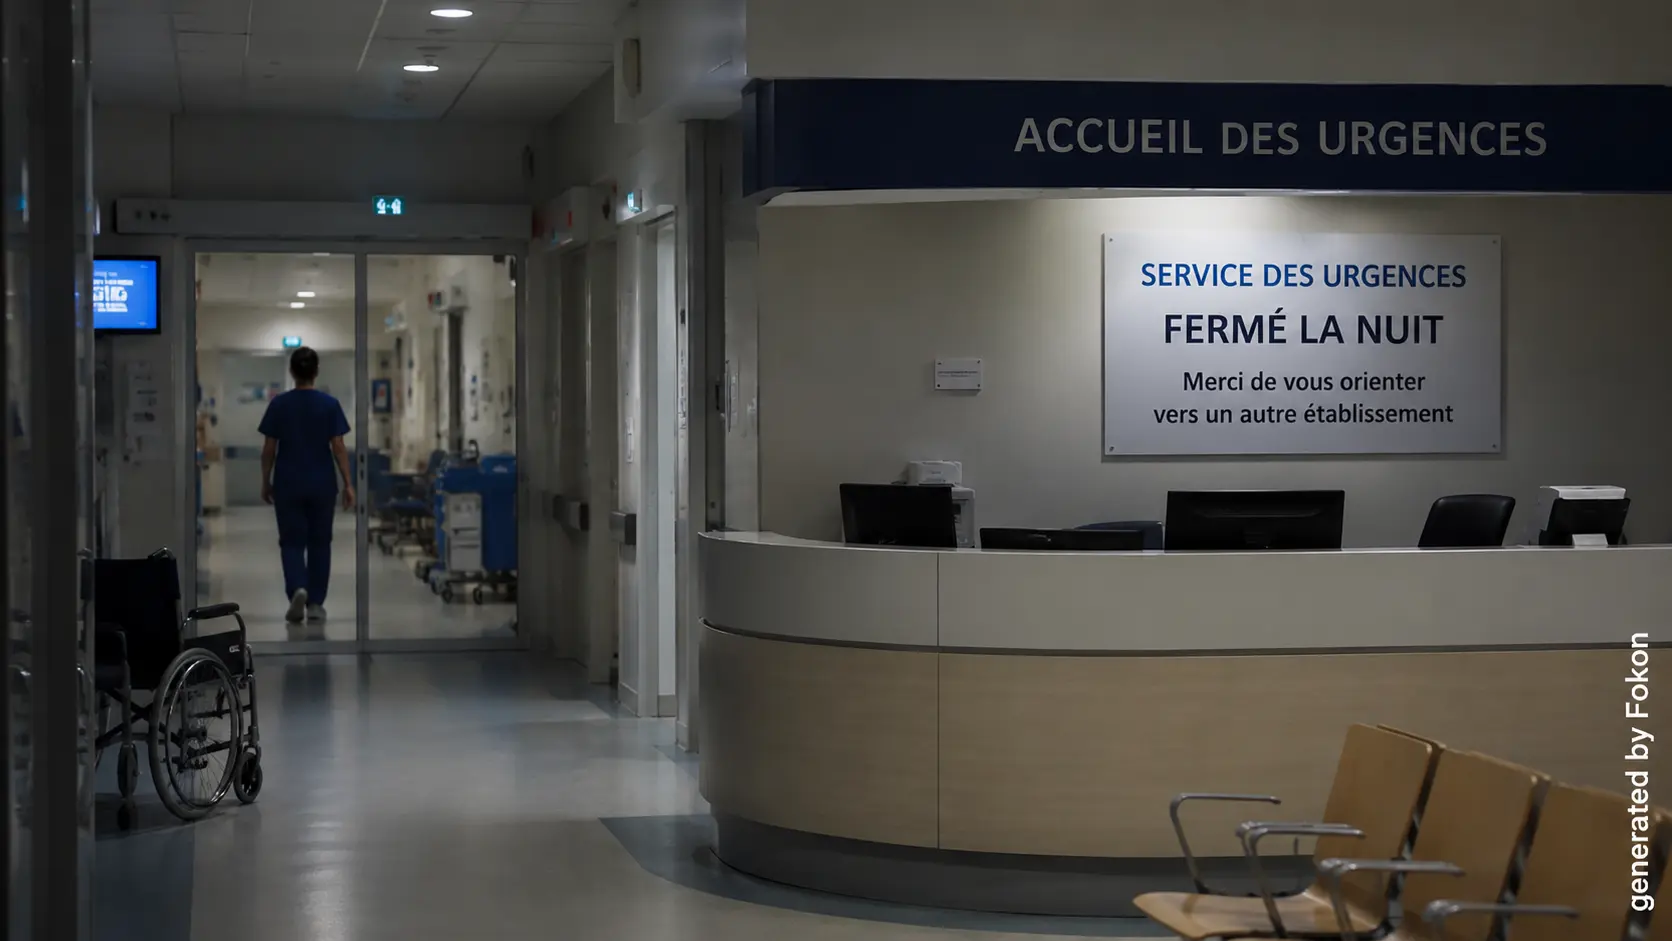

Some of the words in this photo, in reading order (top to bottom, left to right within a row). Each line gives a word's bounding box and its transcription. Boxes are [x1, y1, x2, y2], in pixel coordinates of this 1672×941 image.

[1014, 117, 1203, 154] ACCUEIL
[1221, 122, 1300, 155] DES
[1318, 121, 1547, 157] URGENCES
[1141, 262, 1254, 288] SERVICE
[1263, 263, 1314, 288] DES
[1323, 263, 1467, 289] URGENCES
[1164, 307, 1287, 345] FERMÉ
[1300, 314, 1345, 345] LA
[1357, 314, 1444, 345] NUIT
[1183, 370, 1244, 391] Merci
[1250, 370, 1277, 391] de
[1282, 375, 1334, 391] vous
[1339, 371, 1426, 391] orienter
[1153, 408, 1199, 424] vers
[1205, 408, 1233, 424] un
[1239, 405, 1297, 424] autre
[1303, 402, 1454, 424] établissement
